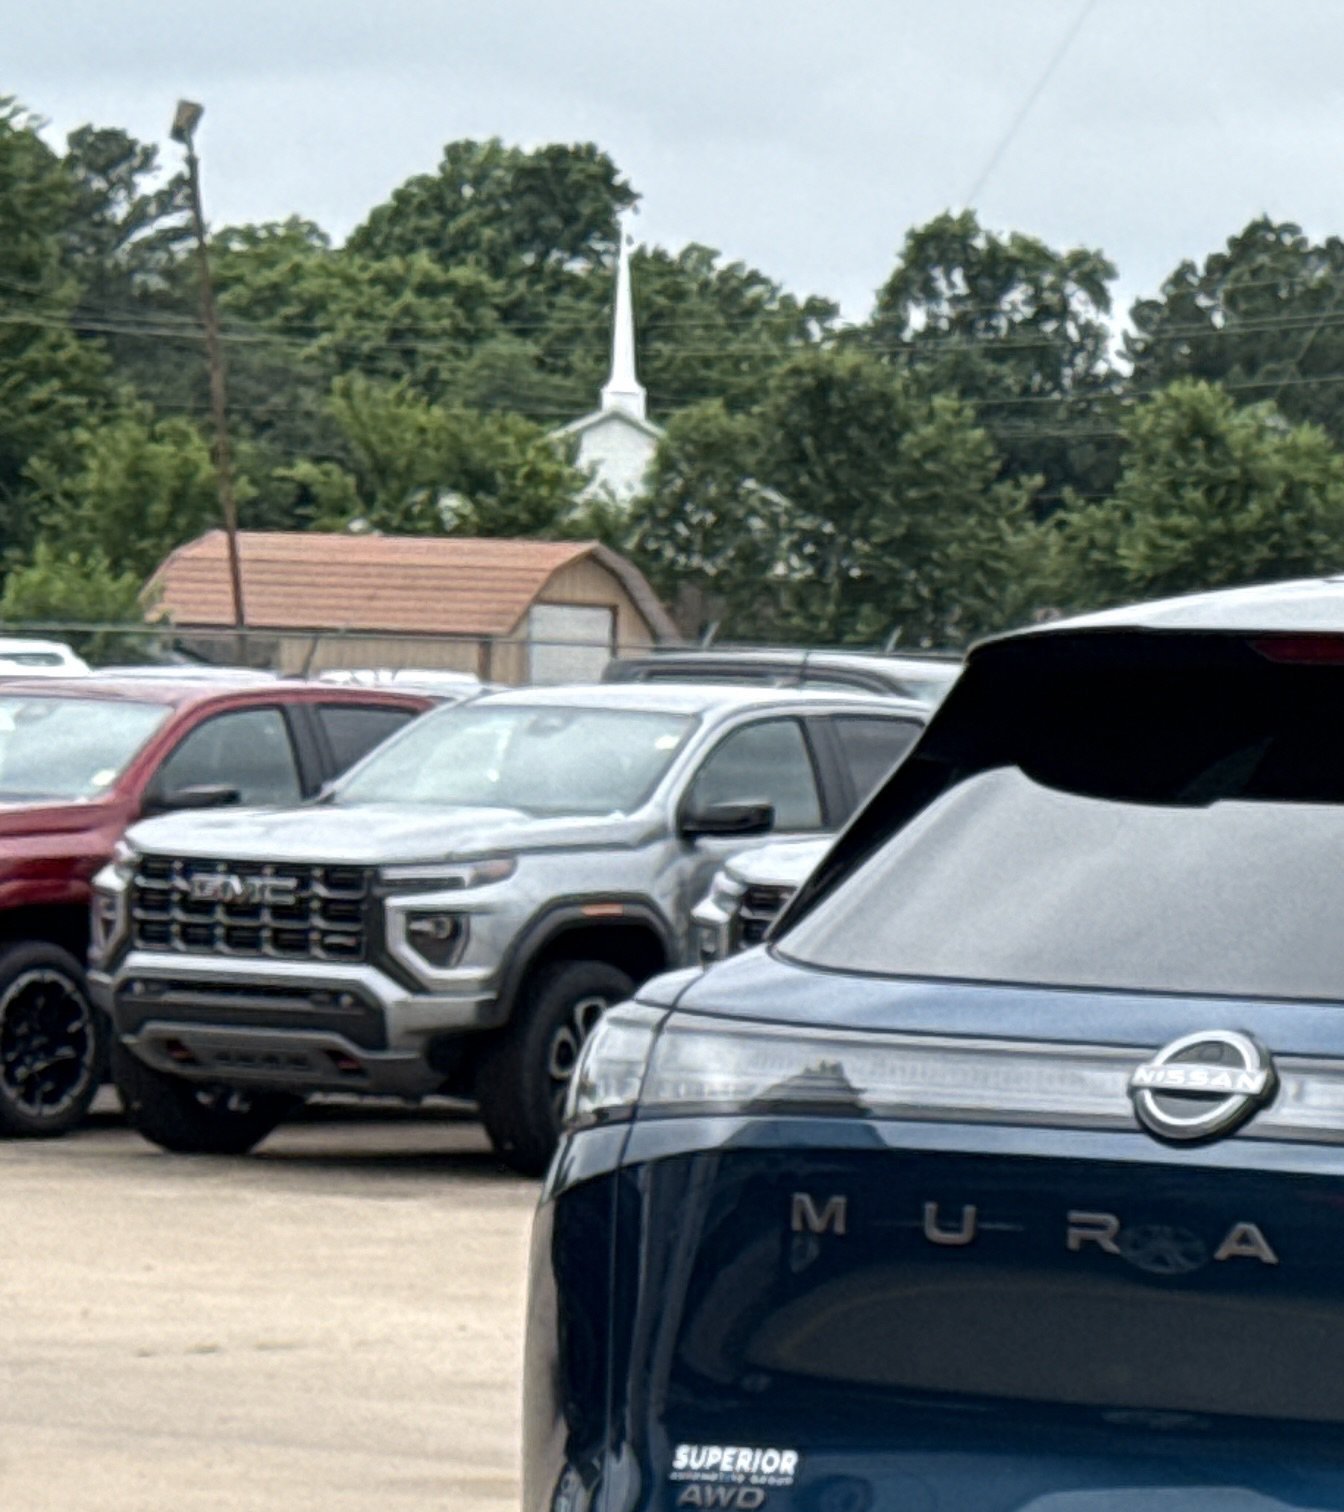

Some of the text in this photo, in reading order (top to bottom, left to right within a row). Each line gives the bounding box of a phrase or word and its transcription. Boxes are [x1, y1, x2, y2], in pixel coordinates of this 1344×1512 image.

[190, 873, 298, 906] GMC
[1132, 1066, 1266, 1094] NISSAN
[672, 1443, 799, 1476] SUPERIOR
[677, 1484, 767, 1510] AWD
